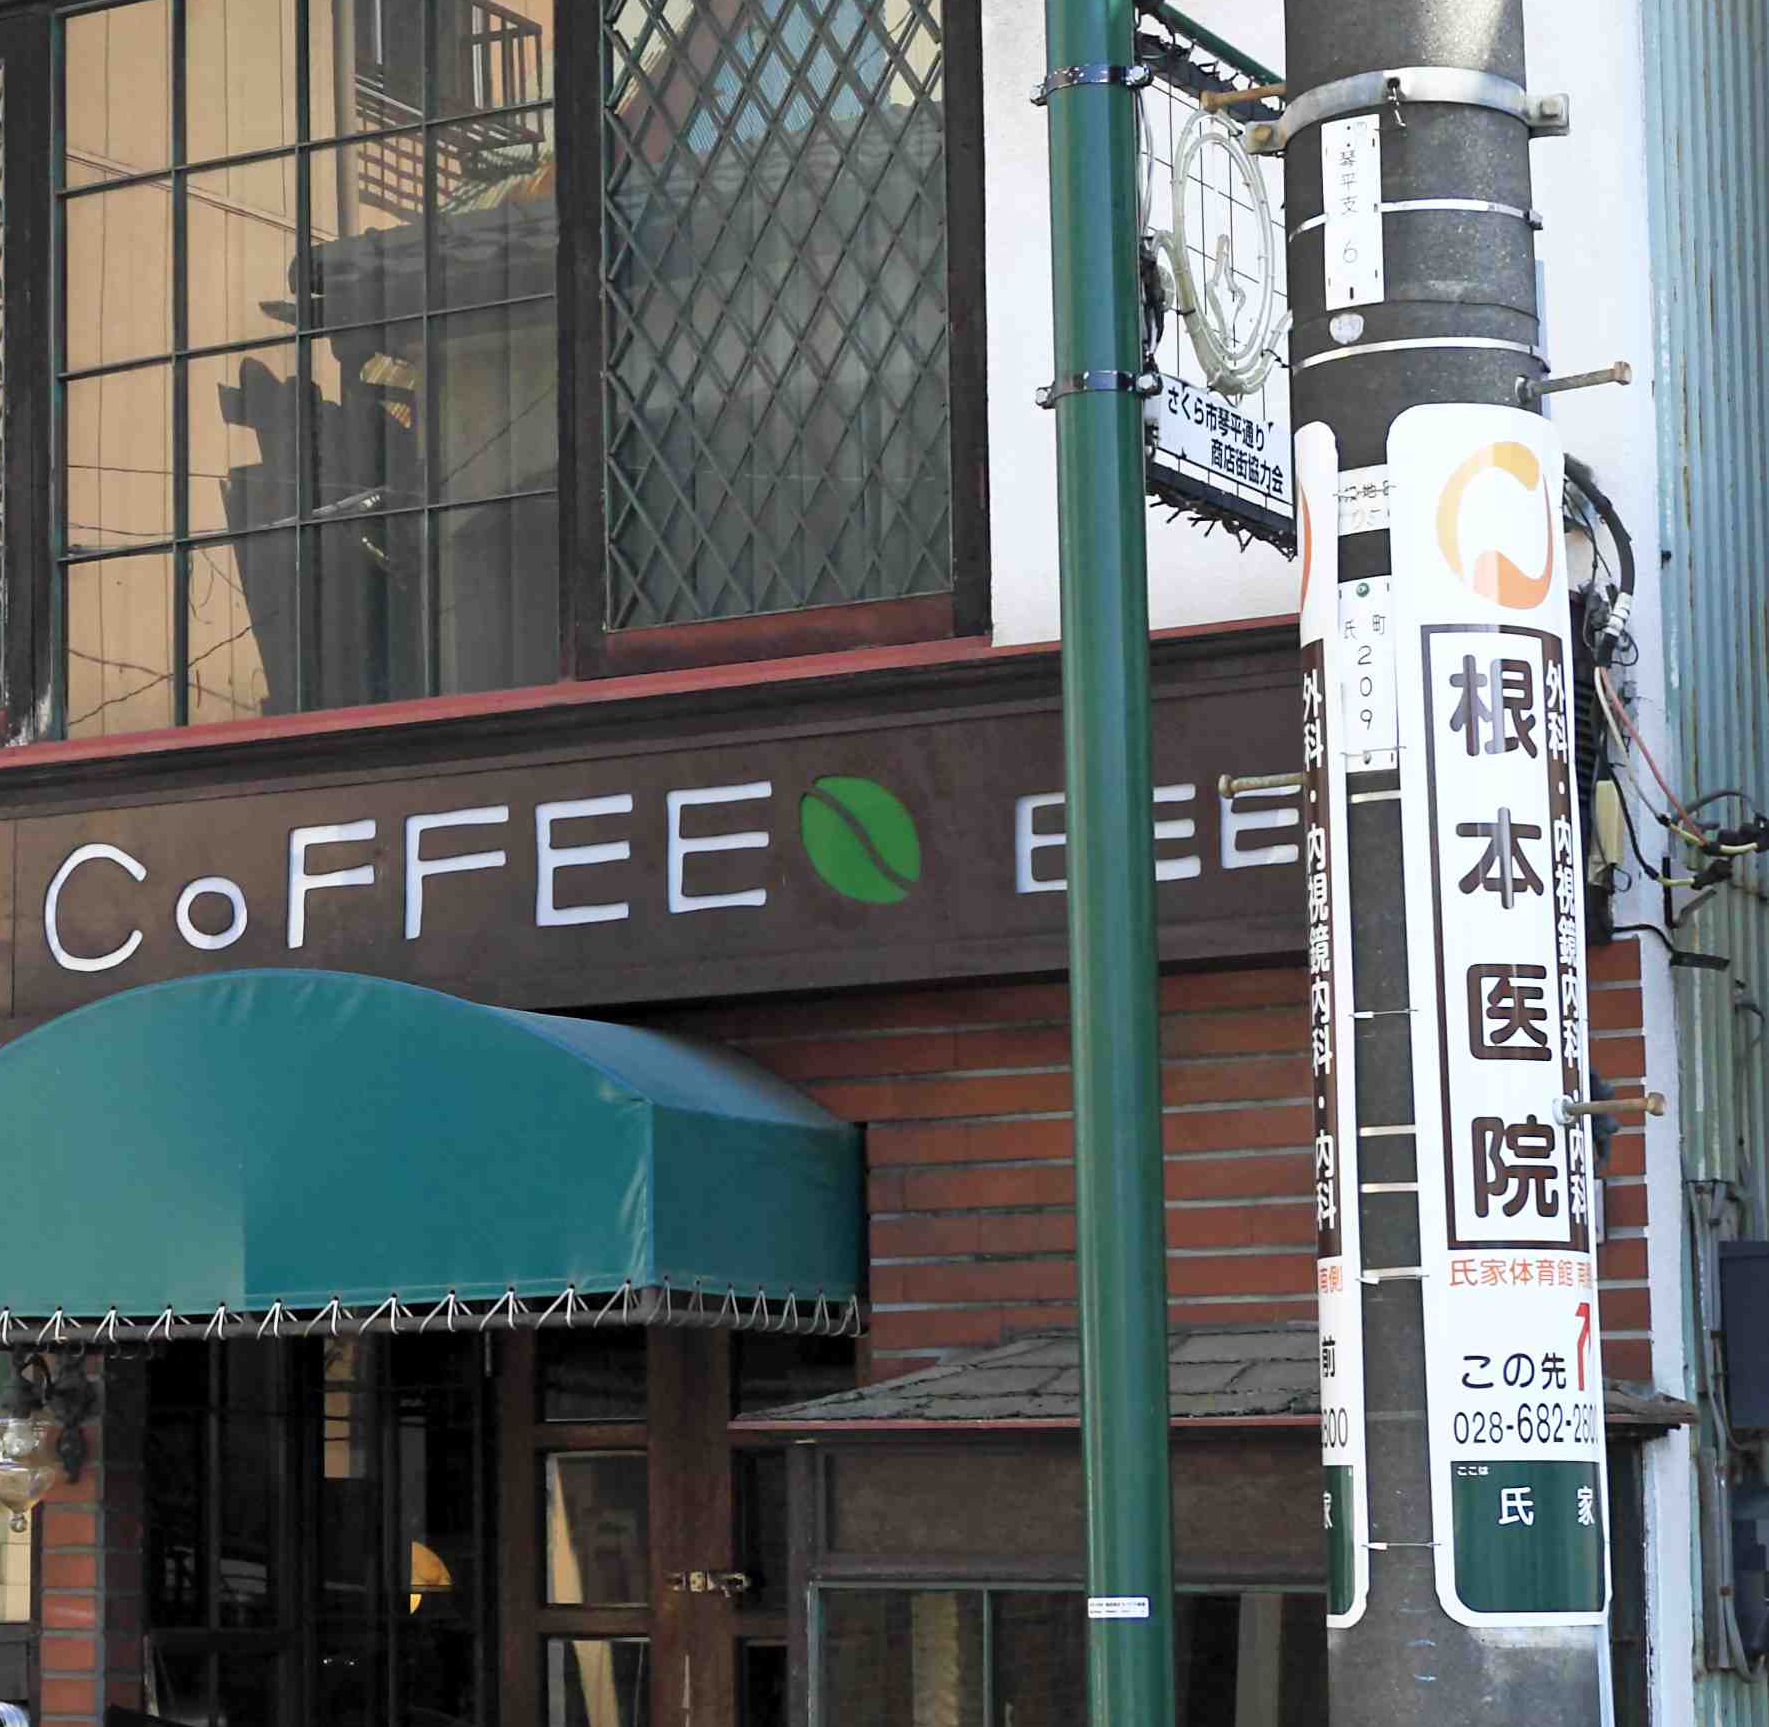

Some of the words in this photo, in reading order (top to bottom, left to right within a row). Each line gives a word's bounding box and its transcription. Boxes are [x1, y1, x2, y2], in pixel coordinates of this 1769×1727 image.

[1167, 385, 1266, 452] さくら市琴平通り
[1210, 437, 1284, 495] 商店街協力会
[1448, 653, 1560, 1219] 根本医院
[1449, 1258, 1574, 1287] 氏家体育館
[1460, 1352, 1568, 1390] この先
[1456, 1465, 1490, 1477] ここは
[1497, 1485, 1596, 1526] 氏家
